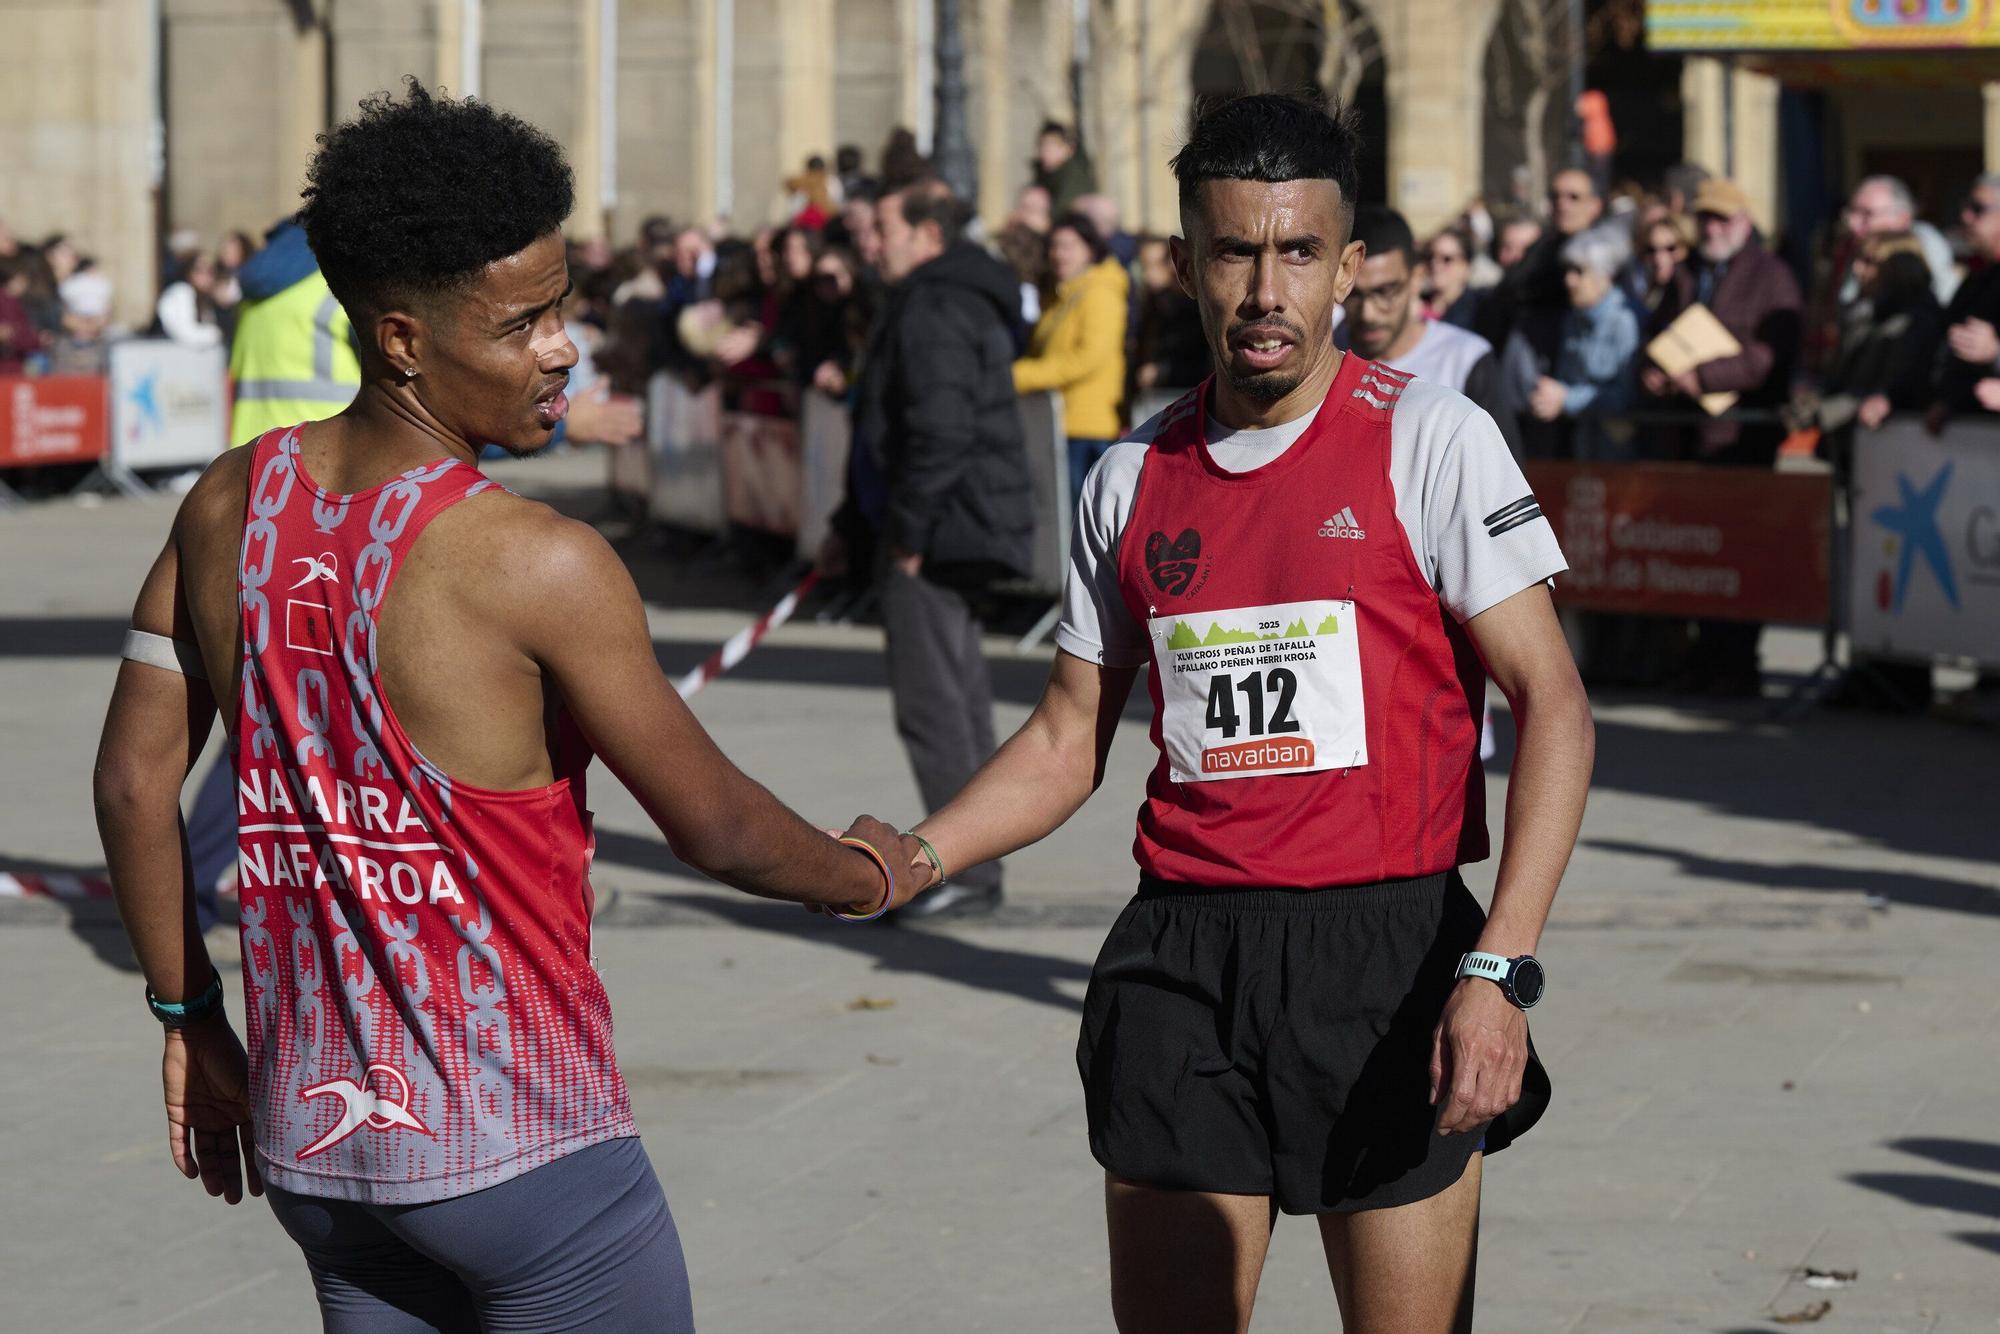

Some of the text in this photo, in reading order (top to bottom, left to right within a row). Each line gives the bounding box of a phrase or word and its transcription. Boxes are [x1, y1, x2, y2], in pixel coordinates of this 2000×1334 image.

[1317, 525, 1366, 540] adidas
[1258, 620, 1280, 630] 2025
[1173, 651, 1317, 673] TAFALLAKO PEÑEN HERRI KROSA
[1176, 639, 1316, 662] XLVI CROSS PEÑAS DE TAFALLA
[1205, 667, 1300, 738] 412
[1206, 743, 1309, 769] navarban
[239, 768, 433, 833] NAVARRA
